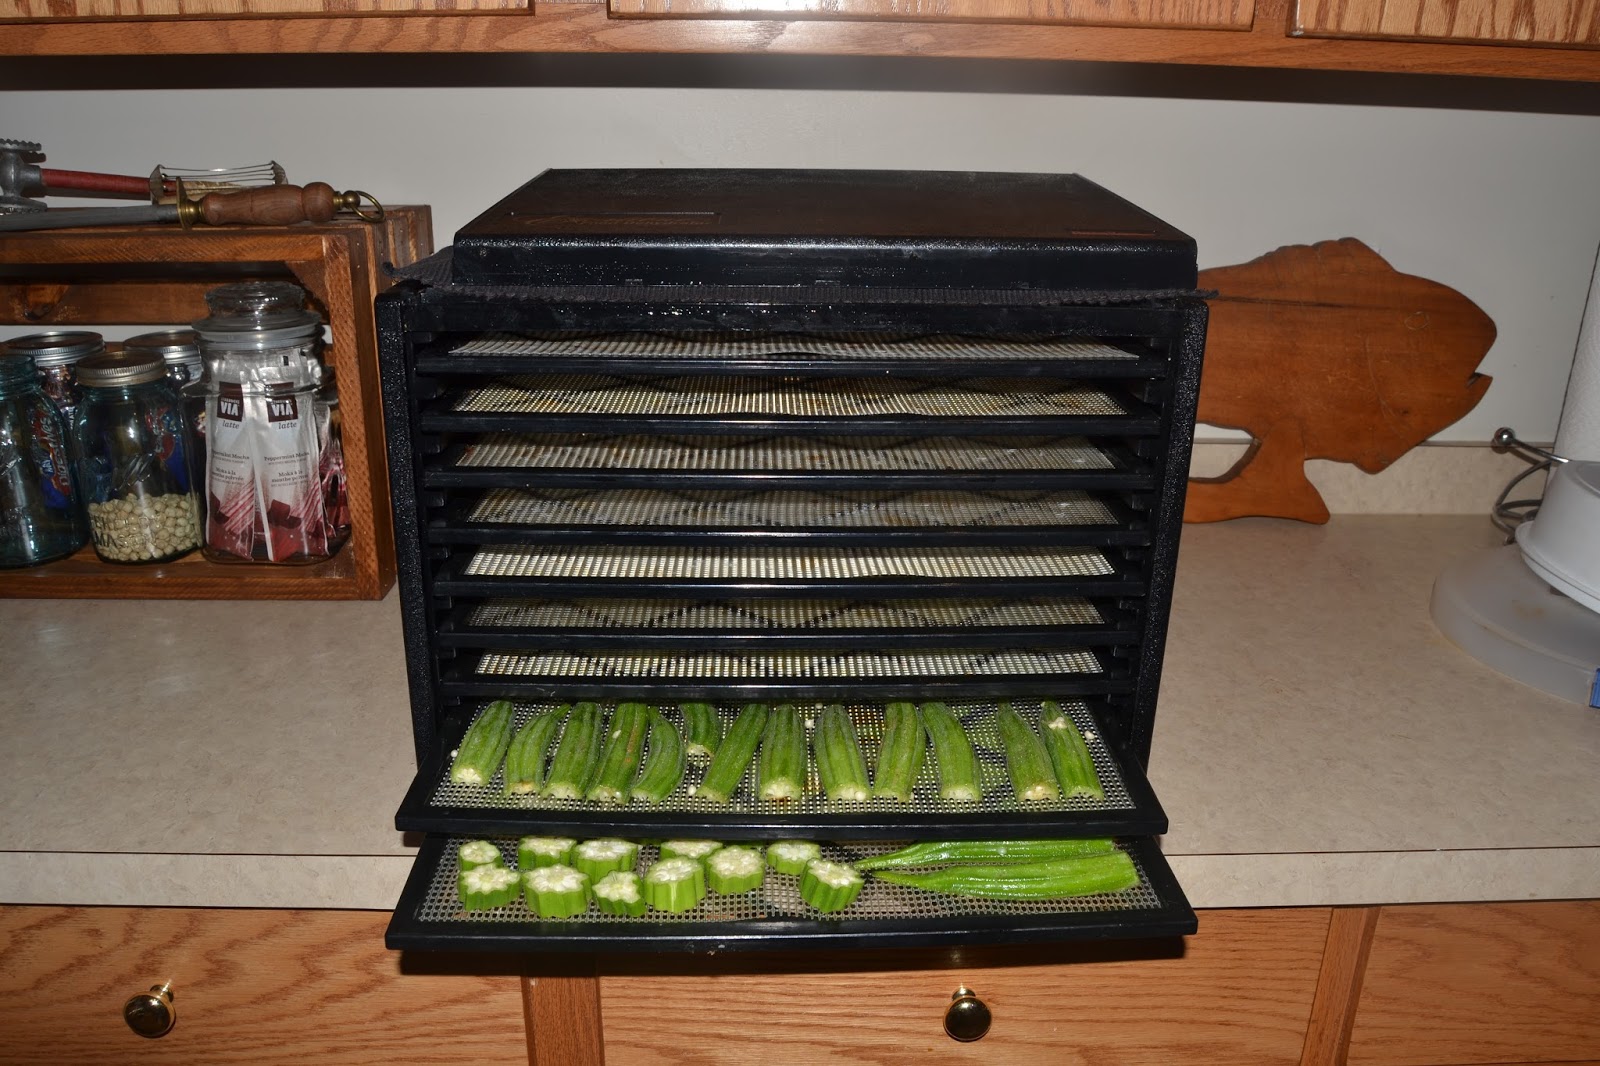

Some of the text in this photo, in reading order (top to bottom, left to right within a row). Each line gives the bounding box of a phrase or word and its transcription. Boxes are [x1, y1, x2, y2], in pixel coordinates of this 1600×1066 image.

[221, 401, 239, 416] VIA
[271, 402, 293, 416] VIA
[222, 421, 239, 429] latte
[278, 421, 297, 430] latte
